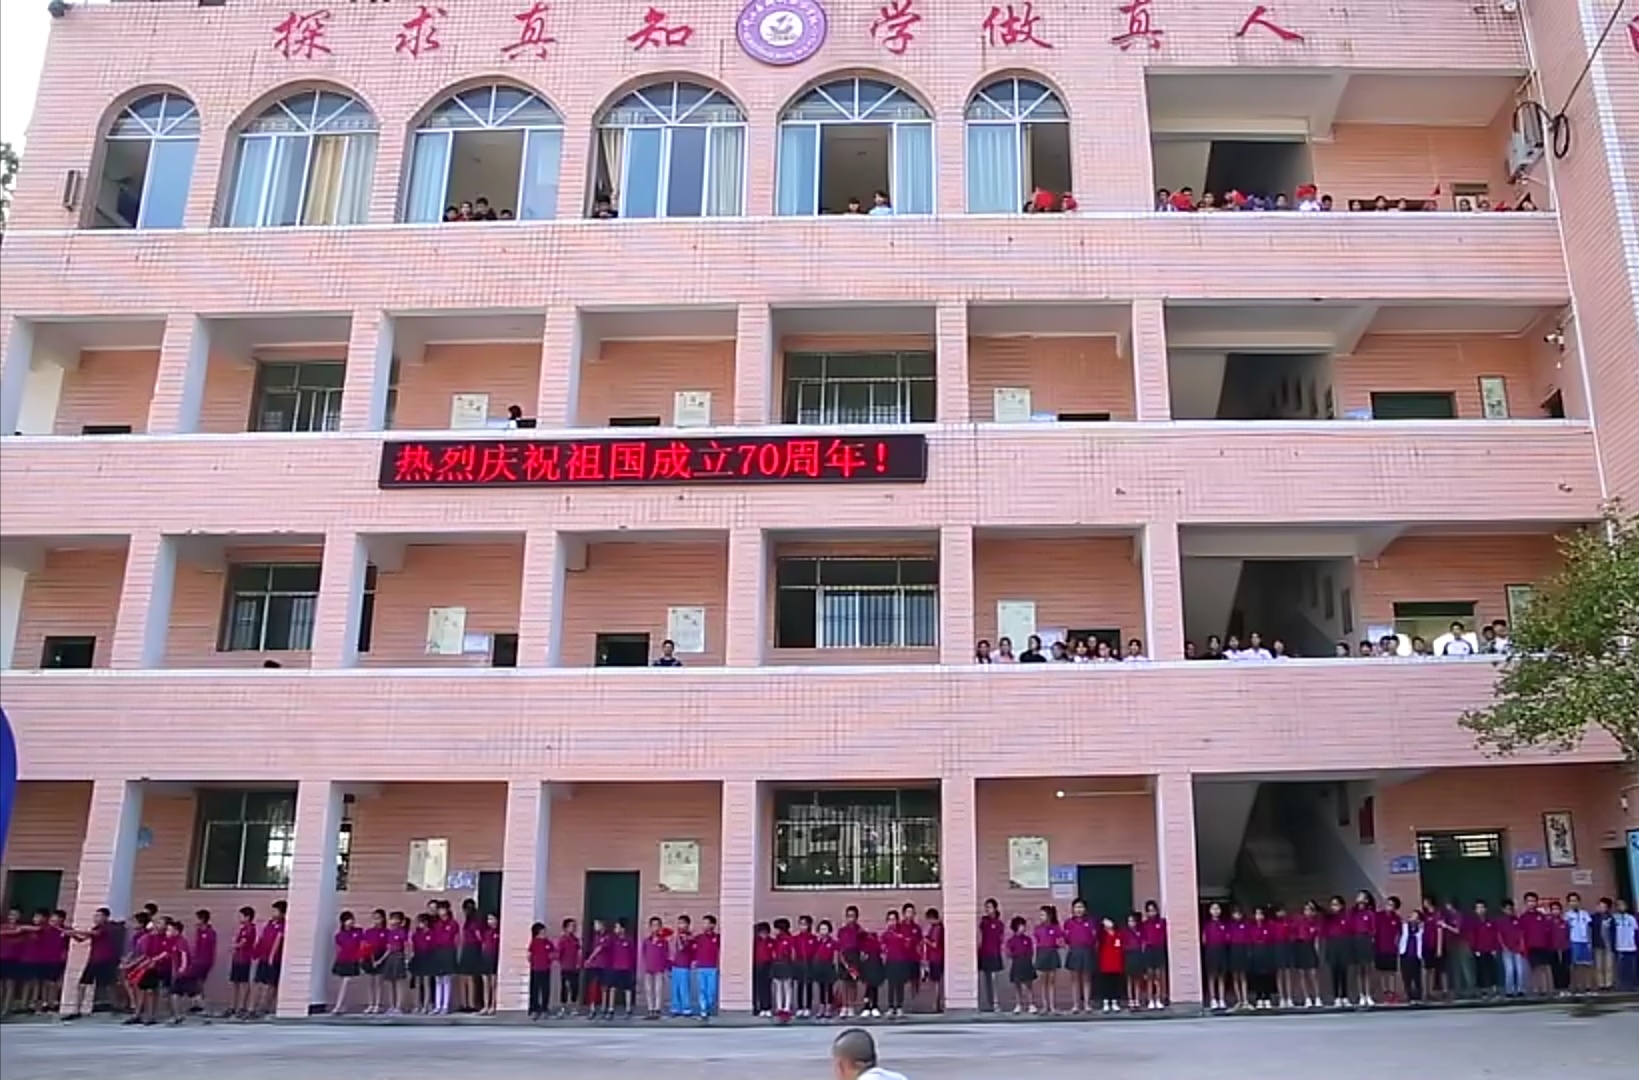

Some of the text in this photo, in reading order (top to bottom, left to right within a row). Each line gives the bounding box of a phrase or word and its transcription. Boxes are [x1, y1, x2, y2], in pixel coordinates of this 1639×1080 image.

[273, 3, 693, 59] 探求真知
[871, 0, 1304, 54] 学做真人
[395, 440, 889, 481] 热烈庆祝祖国成立70周年！
